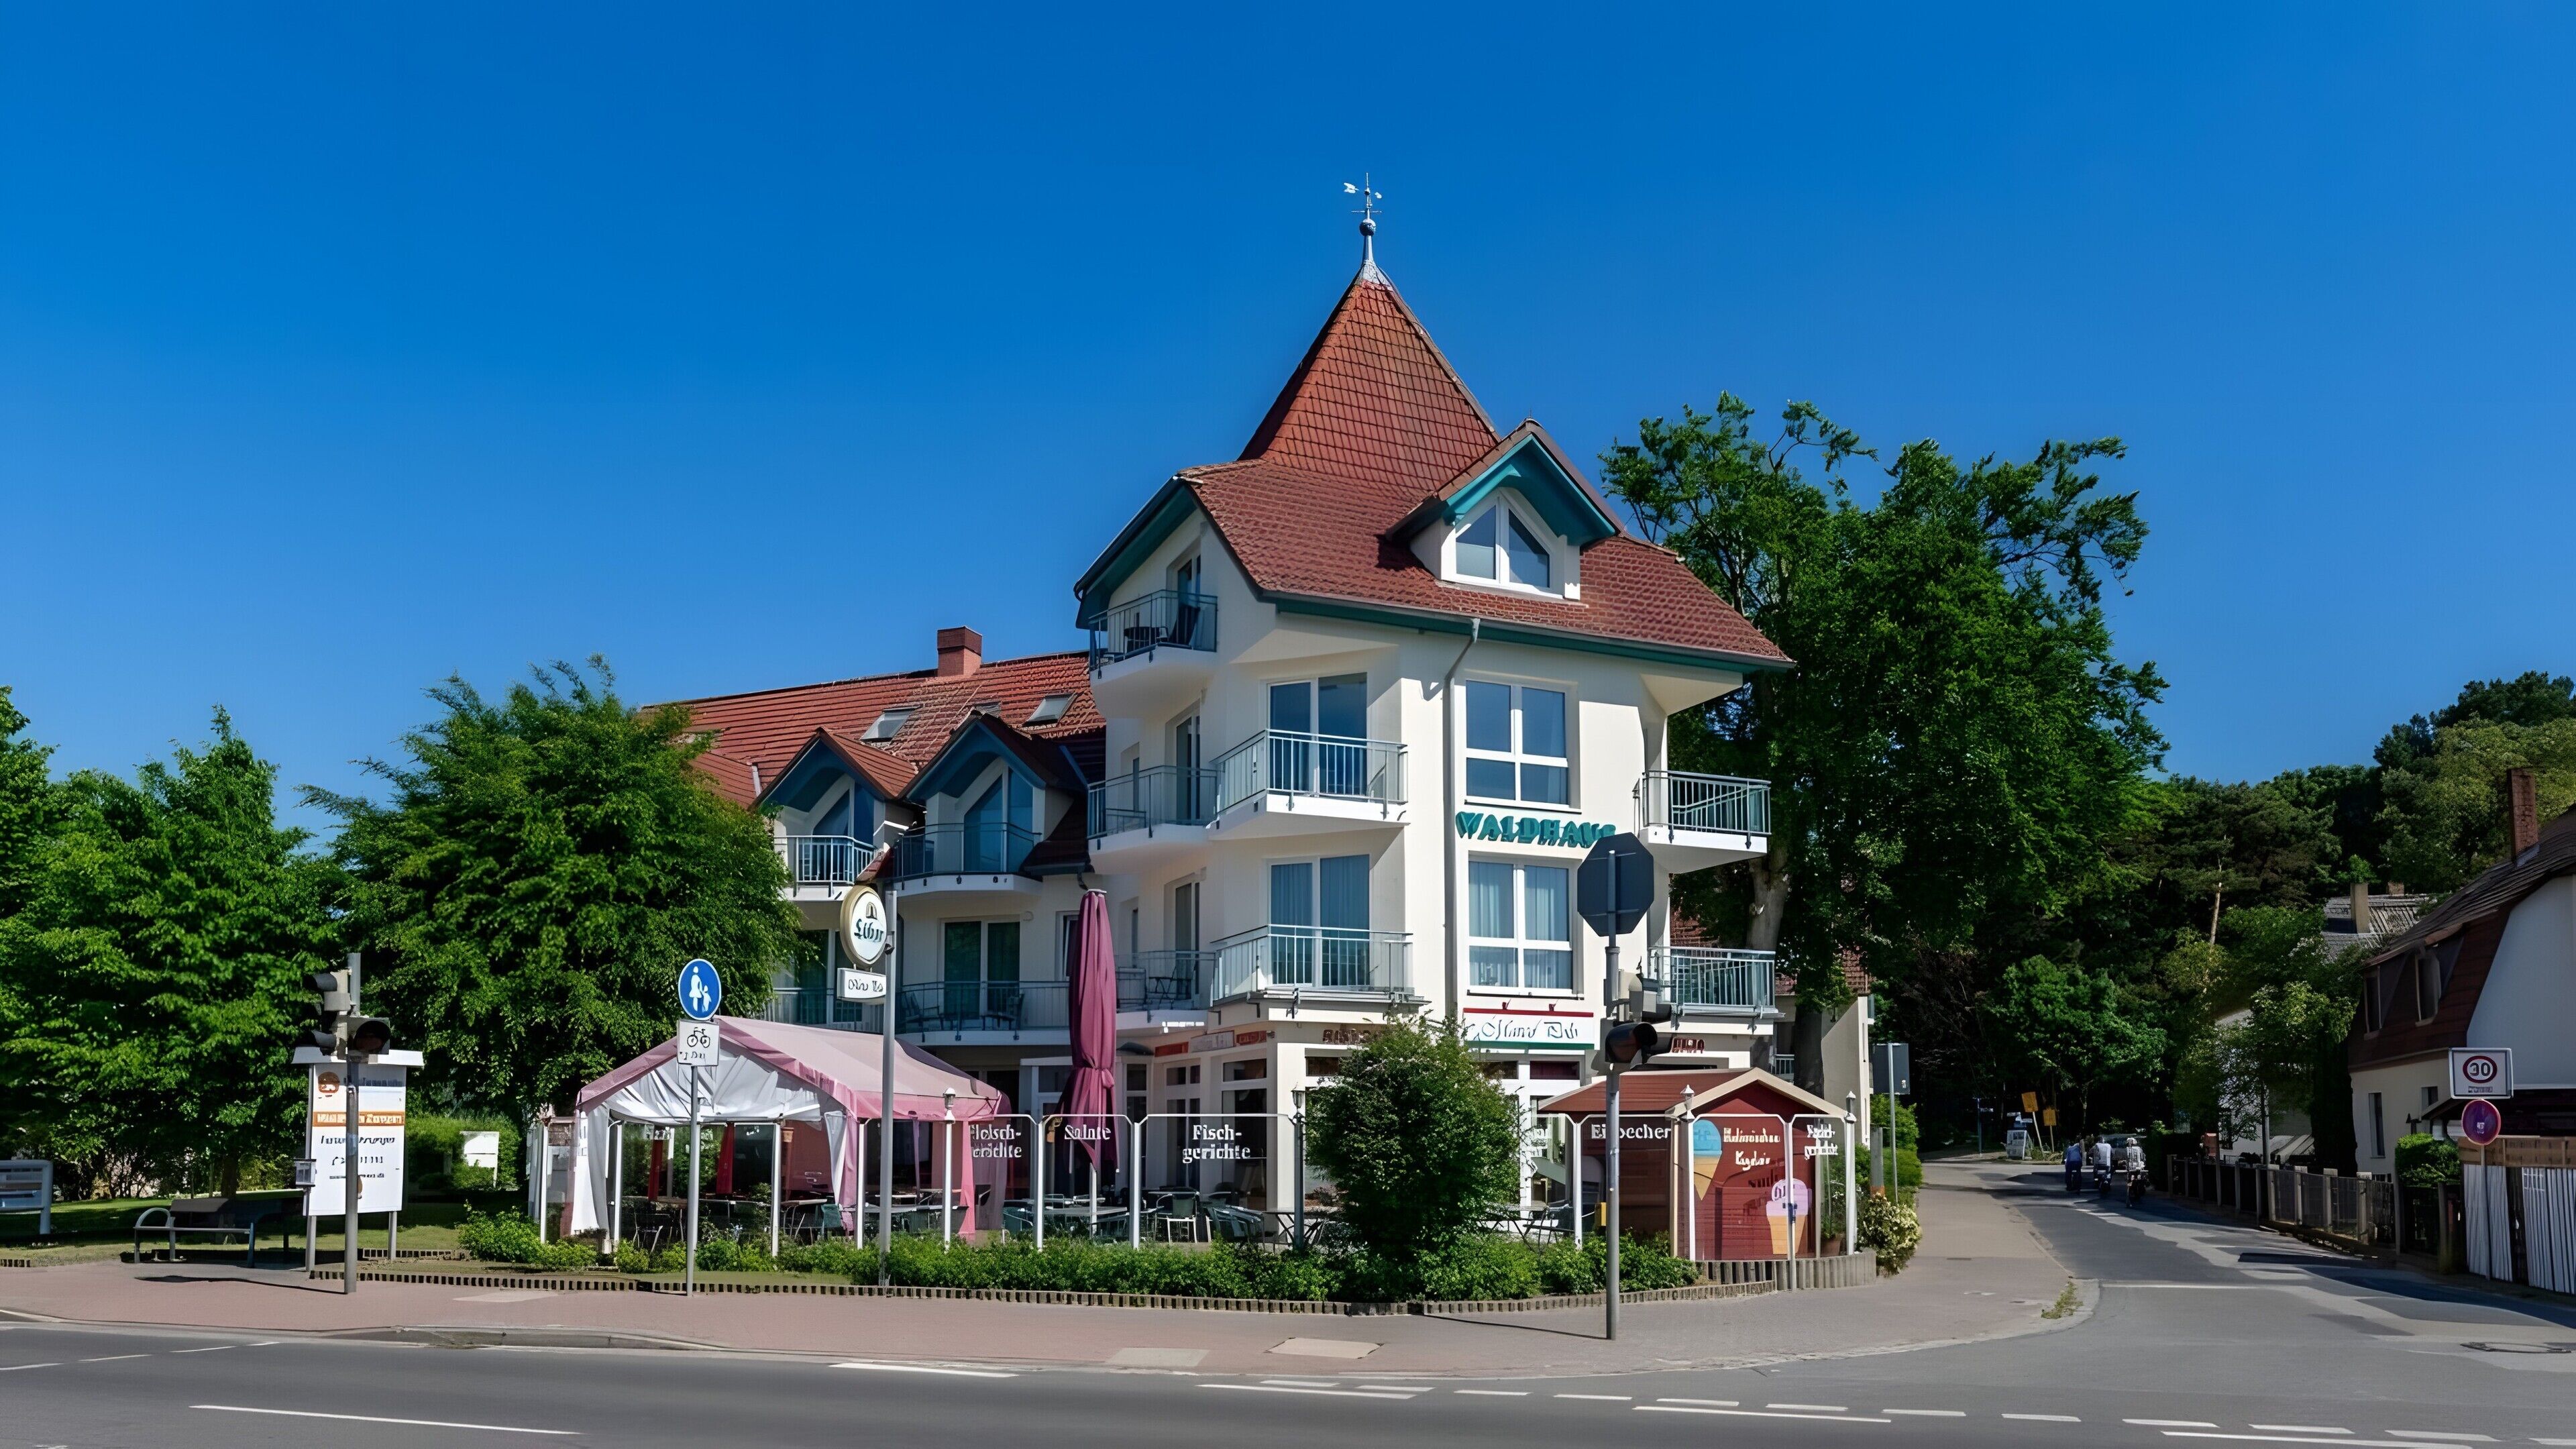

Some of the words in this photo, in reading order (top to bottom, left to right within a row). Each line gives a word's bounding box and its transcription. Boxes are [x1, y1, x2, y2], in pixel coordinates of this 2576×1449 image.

[2469, 1062, 2491, 1077] 30
[1193, 1124, 1242, 1140] Fisch-
[1591, 1124, 1672, 1139] Eiecher
[1182, 1142, 1250, 1164] gerichte
